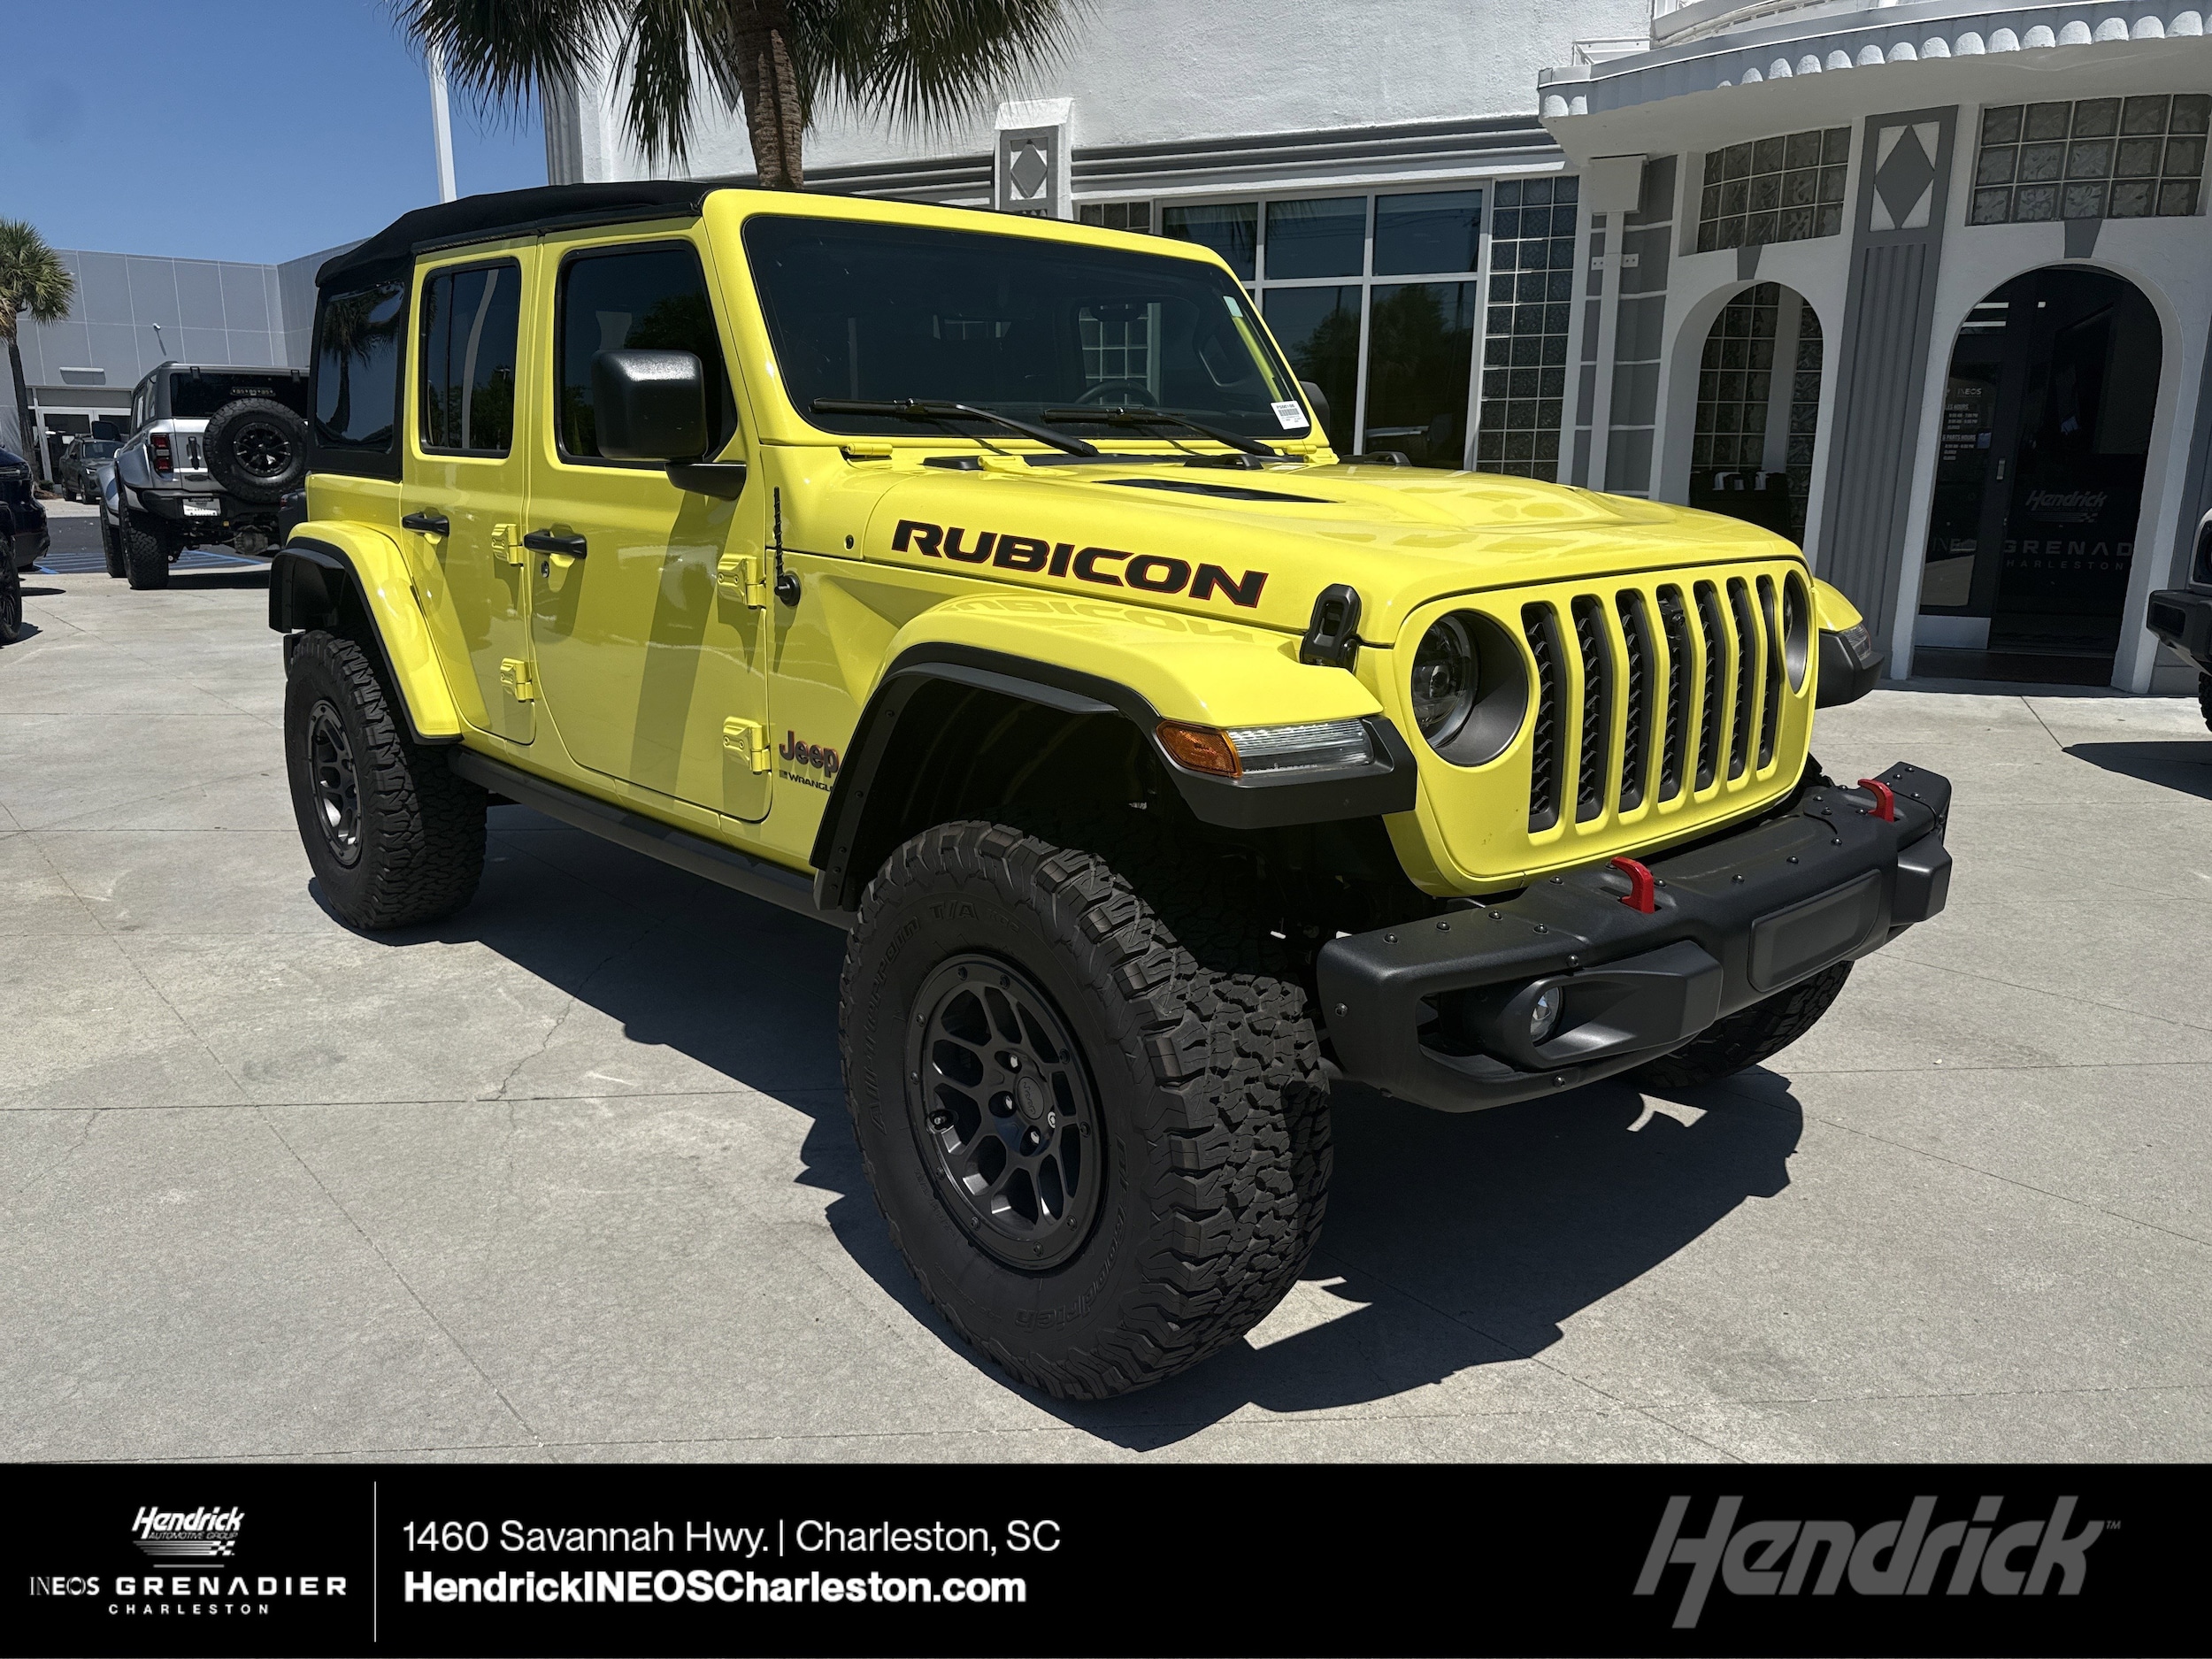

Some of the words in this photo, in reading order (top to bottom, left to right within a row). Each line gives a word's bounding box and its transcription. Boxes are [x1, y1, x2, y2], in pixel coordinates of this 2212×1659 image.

[2025, 489, 2108, 511] Hendrick
[2004, 539, 2133, 557] GRENAD
[891, 519, 1269, 609] RUBICON
[2006, 559, 2124, 571] HARLESTON
[779, 730, 839, 778] Jeep
[787, 772, 833, 792] WRANGL
[929, 899, 980, 922] T/A
[1022, 1081, 1036, 1115] Jeep
